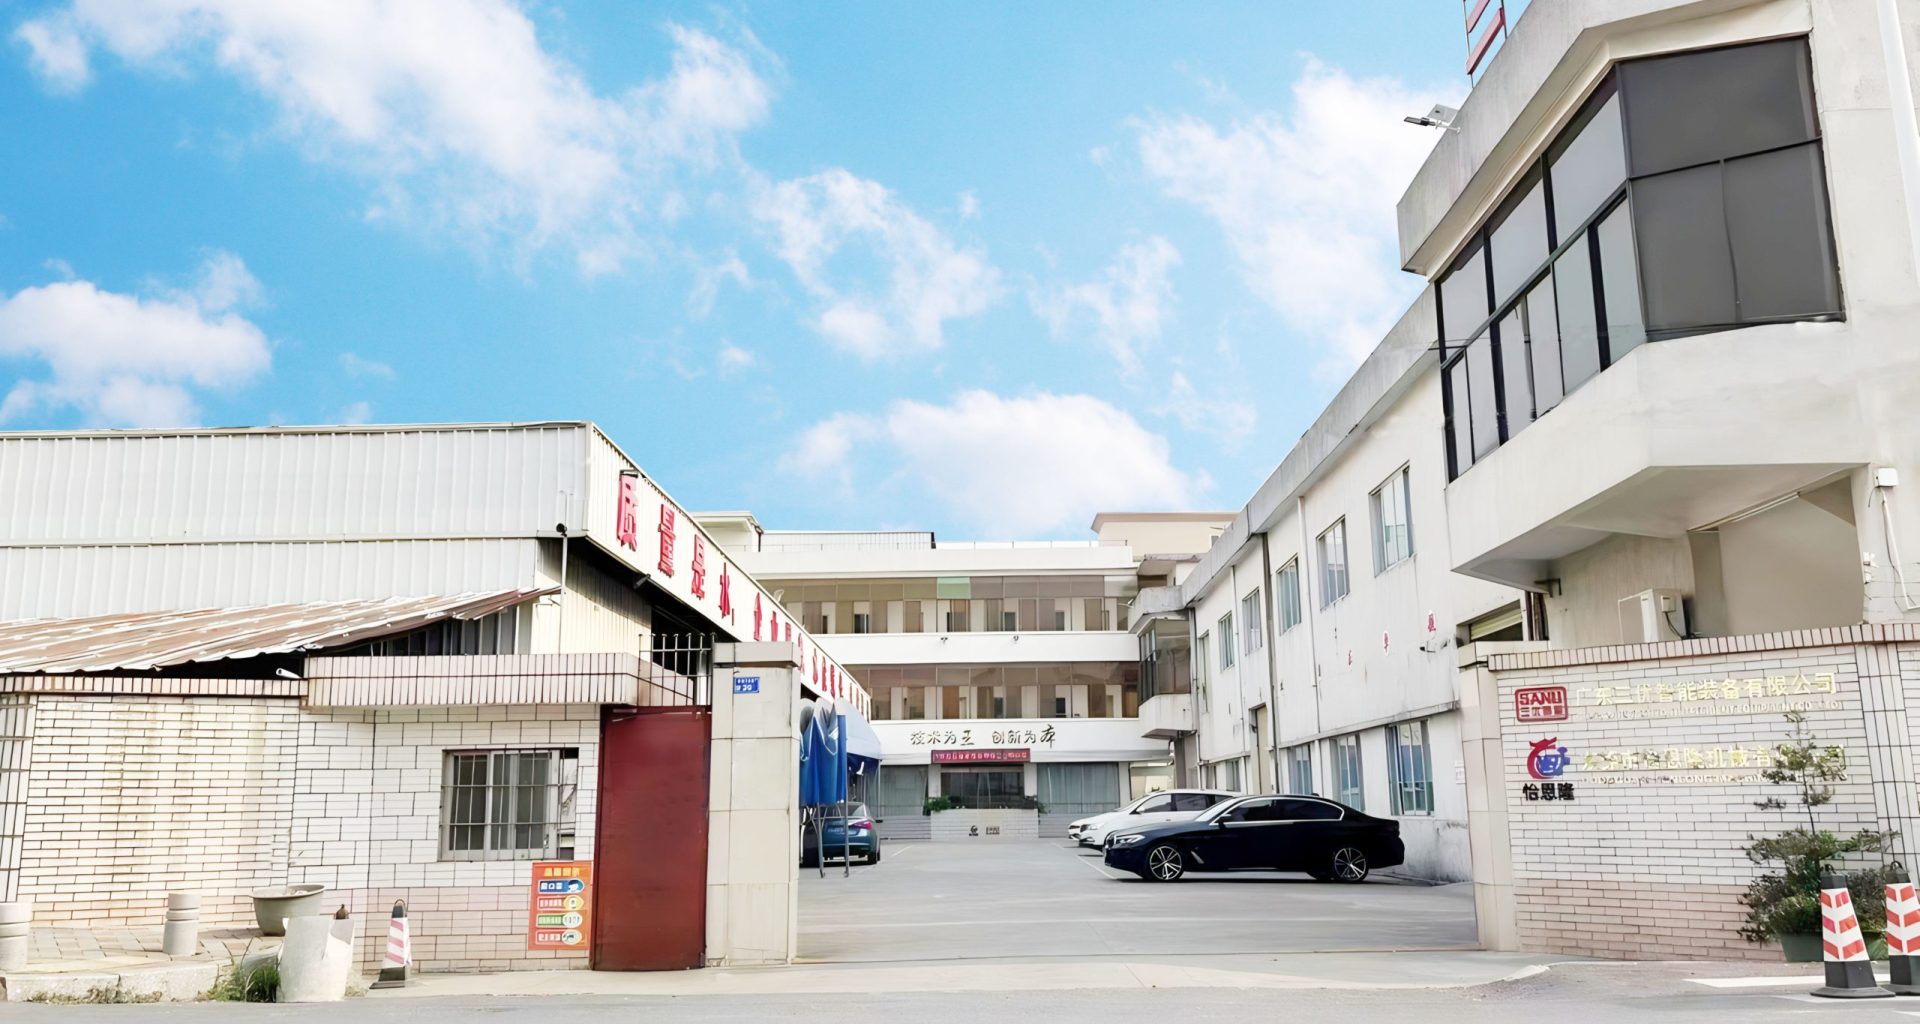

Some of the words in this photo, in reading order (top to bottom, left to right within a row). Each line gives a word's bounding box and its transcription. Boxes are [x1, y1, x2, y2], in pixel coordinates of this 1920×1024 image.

[1519, 691, 1562, 705] SANU
[1576, 672, 1837, 706] 广东三优智能装备有限公司
[1523, 782, 1575, 801] 怡恩隆
